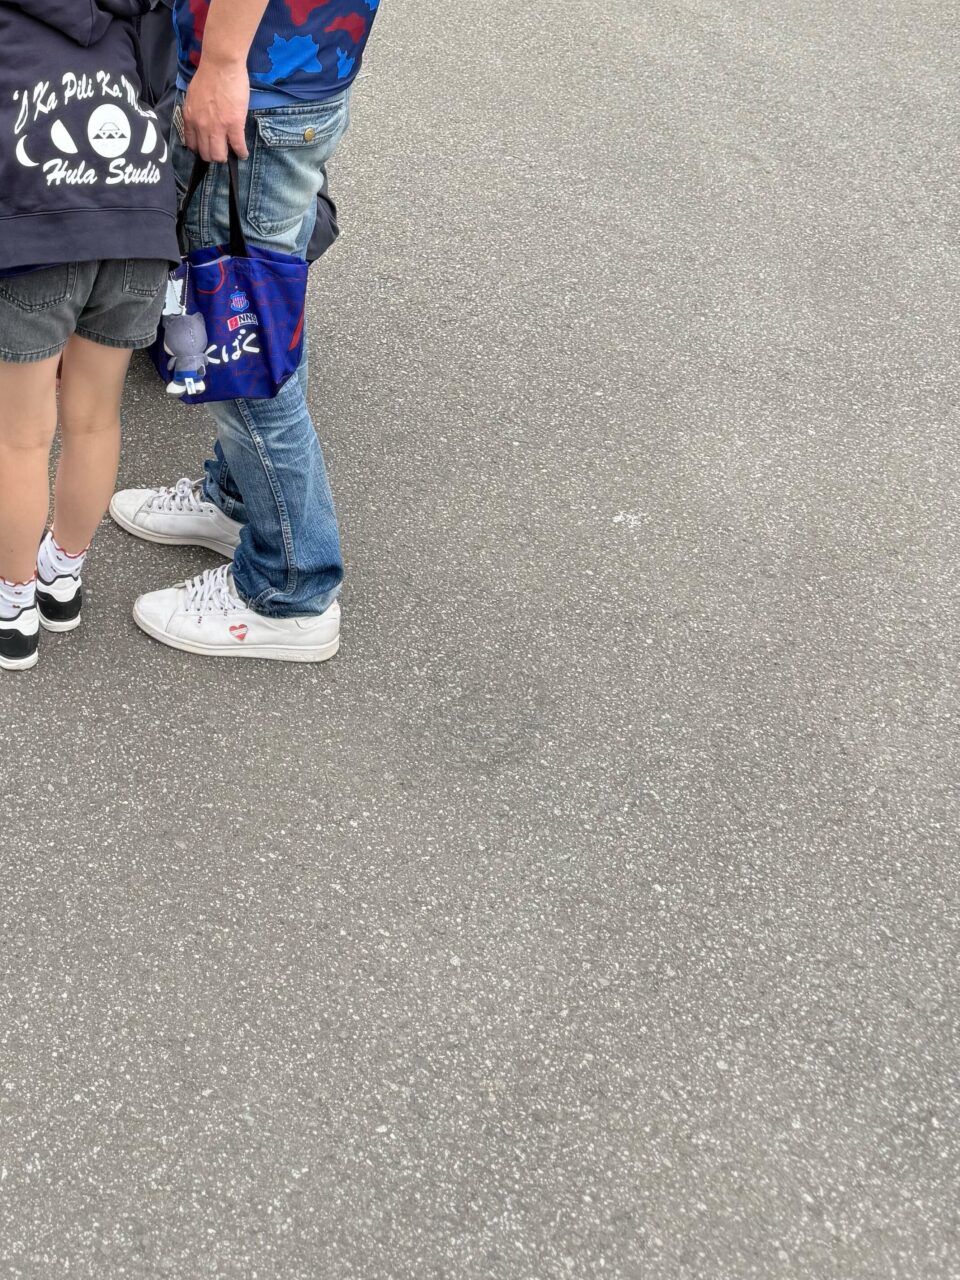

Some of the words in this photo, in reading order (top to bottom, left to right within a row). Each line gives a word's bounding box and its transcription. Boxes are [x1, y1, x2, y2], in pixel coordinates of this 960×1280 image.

[32, 81, 58, 121] Ka
[62, 71, 94, 105] Pili
[96, 70, 122, 98] Ka
[42, 158, 98, 186] Hula
[105, 157, 161, 185] Studio
